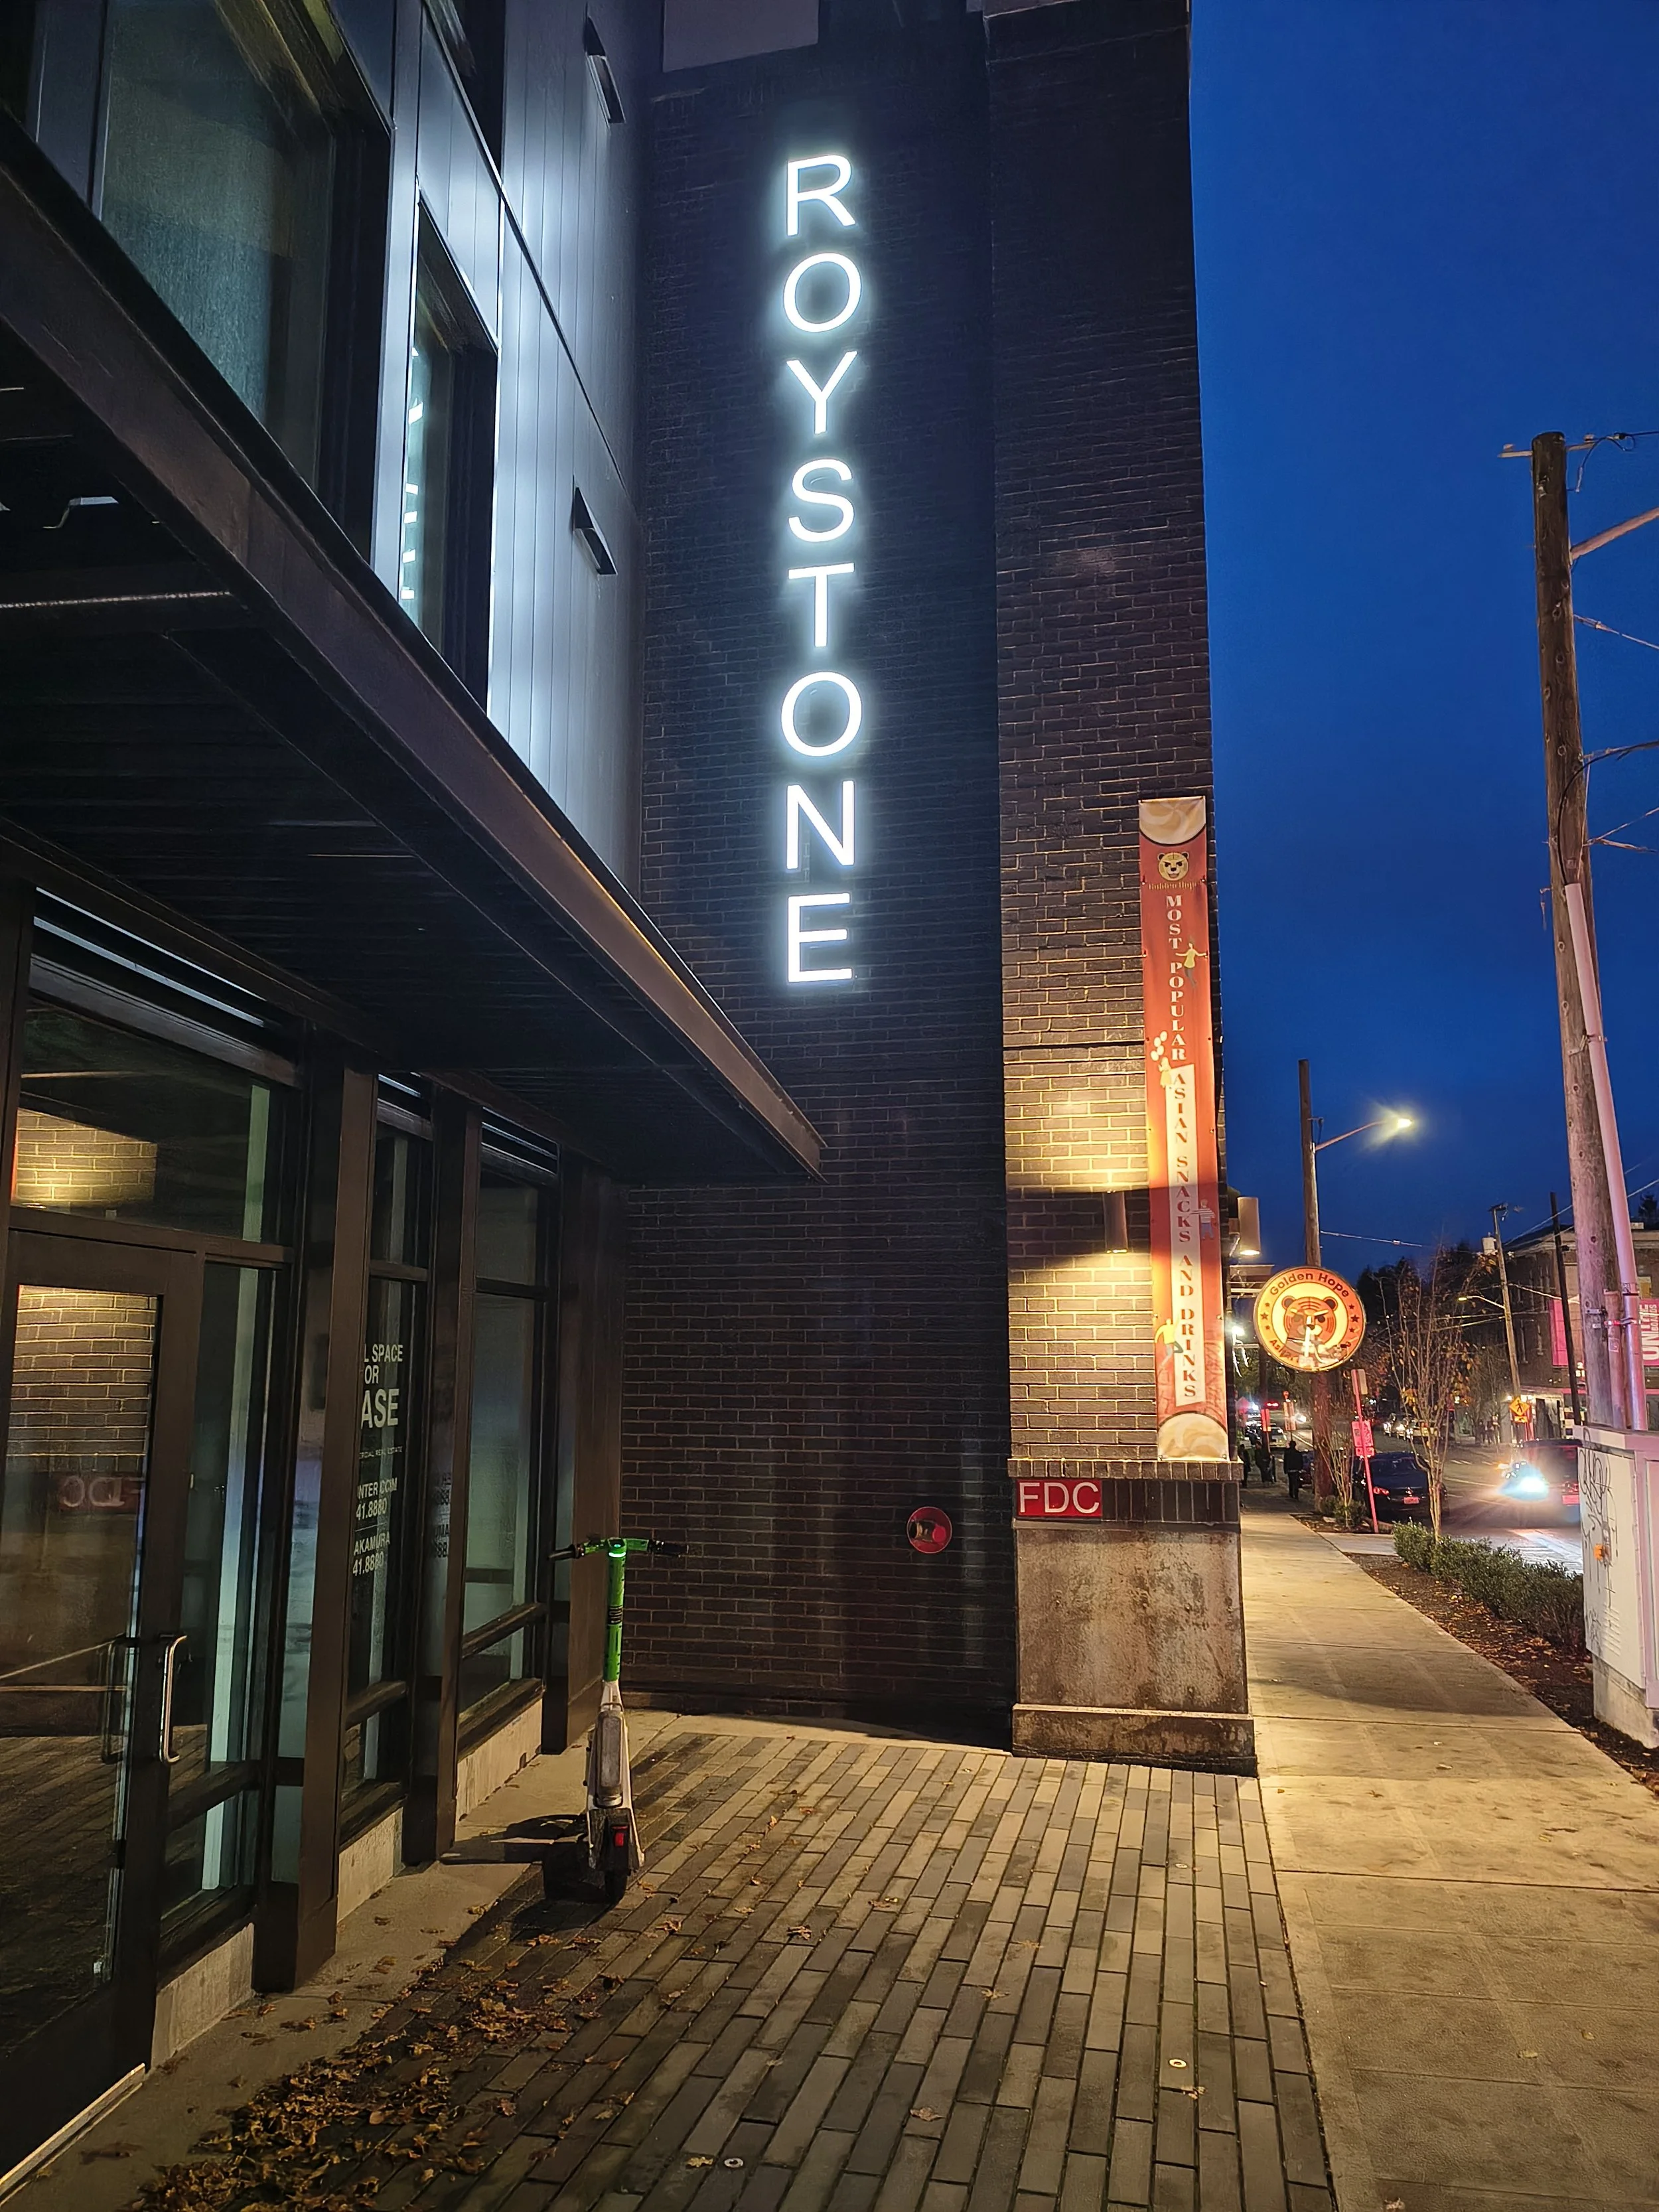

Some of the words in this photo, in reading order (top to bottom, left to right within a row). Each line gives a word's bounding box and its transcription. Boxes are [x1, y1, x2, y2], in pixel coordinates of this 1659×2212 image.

[782, 154, 862, 986] ROYSTONE
[1165, 895, 1183, 950] MOST
[1170, 962, 1187, 1061] POPULAR
[1172, 1072, 1188, 1144] ASIAN
[1176, 1155, 1192, 1243] SNACKS
[1179, 1254, 1194, 1297] AND
[1269, 1272, 1314, 1296] Golden
[1318, 1272, 1350, 1298] Hope
[364, 1364, 380, 1384] OR
[372, 1343, 403, 1363] SPACE
[1181, 1308, 1197, 1398] DRINKS
[360, 1388, 399, 1430] ASE
[356, 1497, 388, 1520] 41.8880
[1019, 1482, 1100, 1514] FDC
[354, 1531, 390, 1556] AKAMURA
